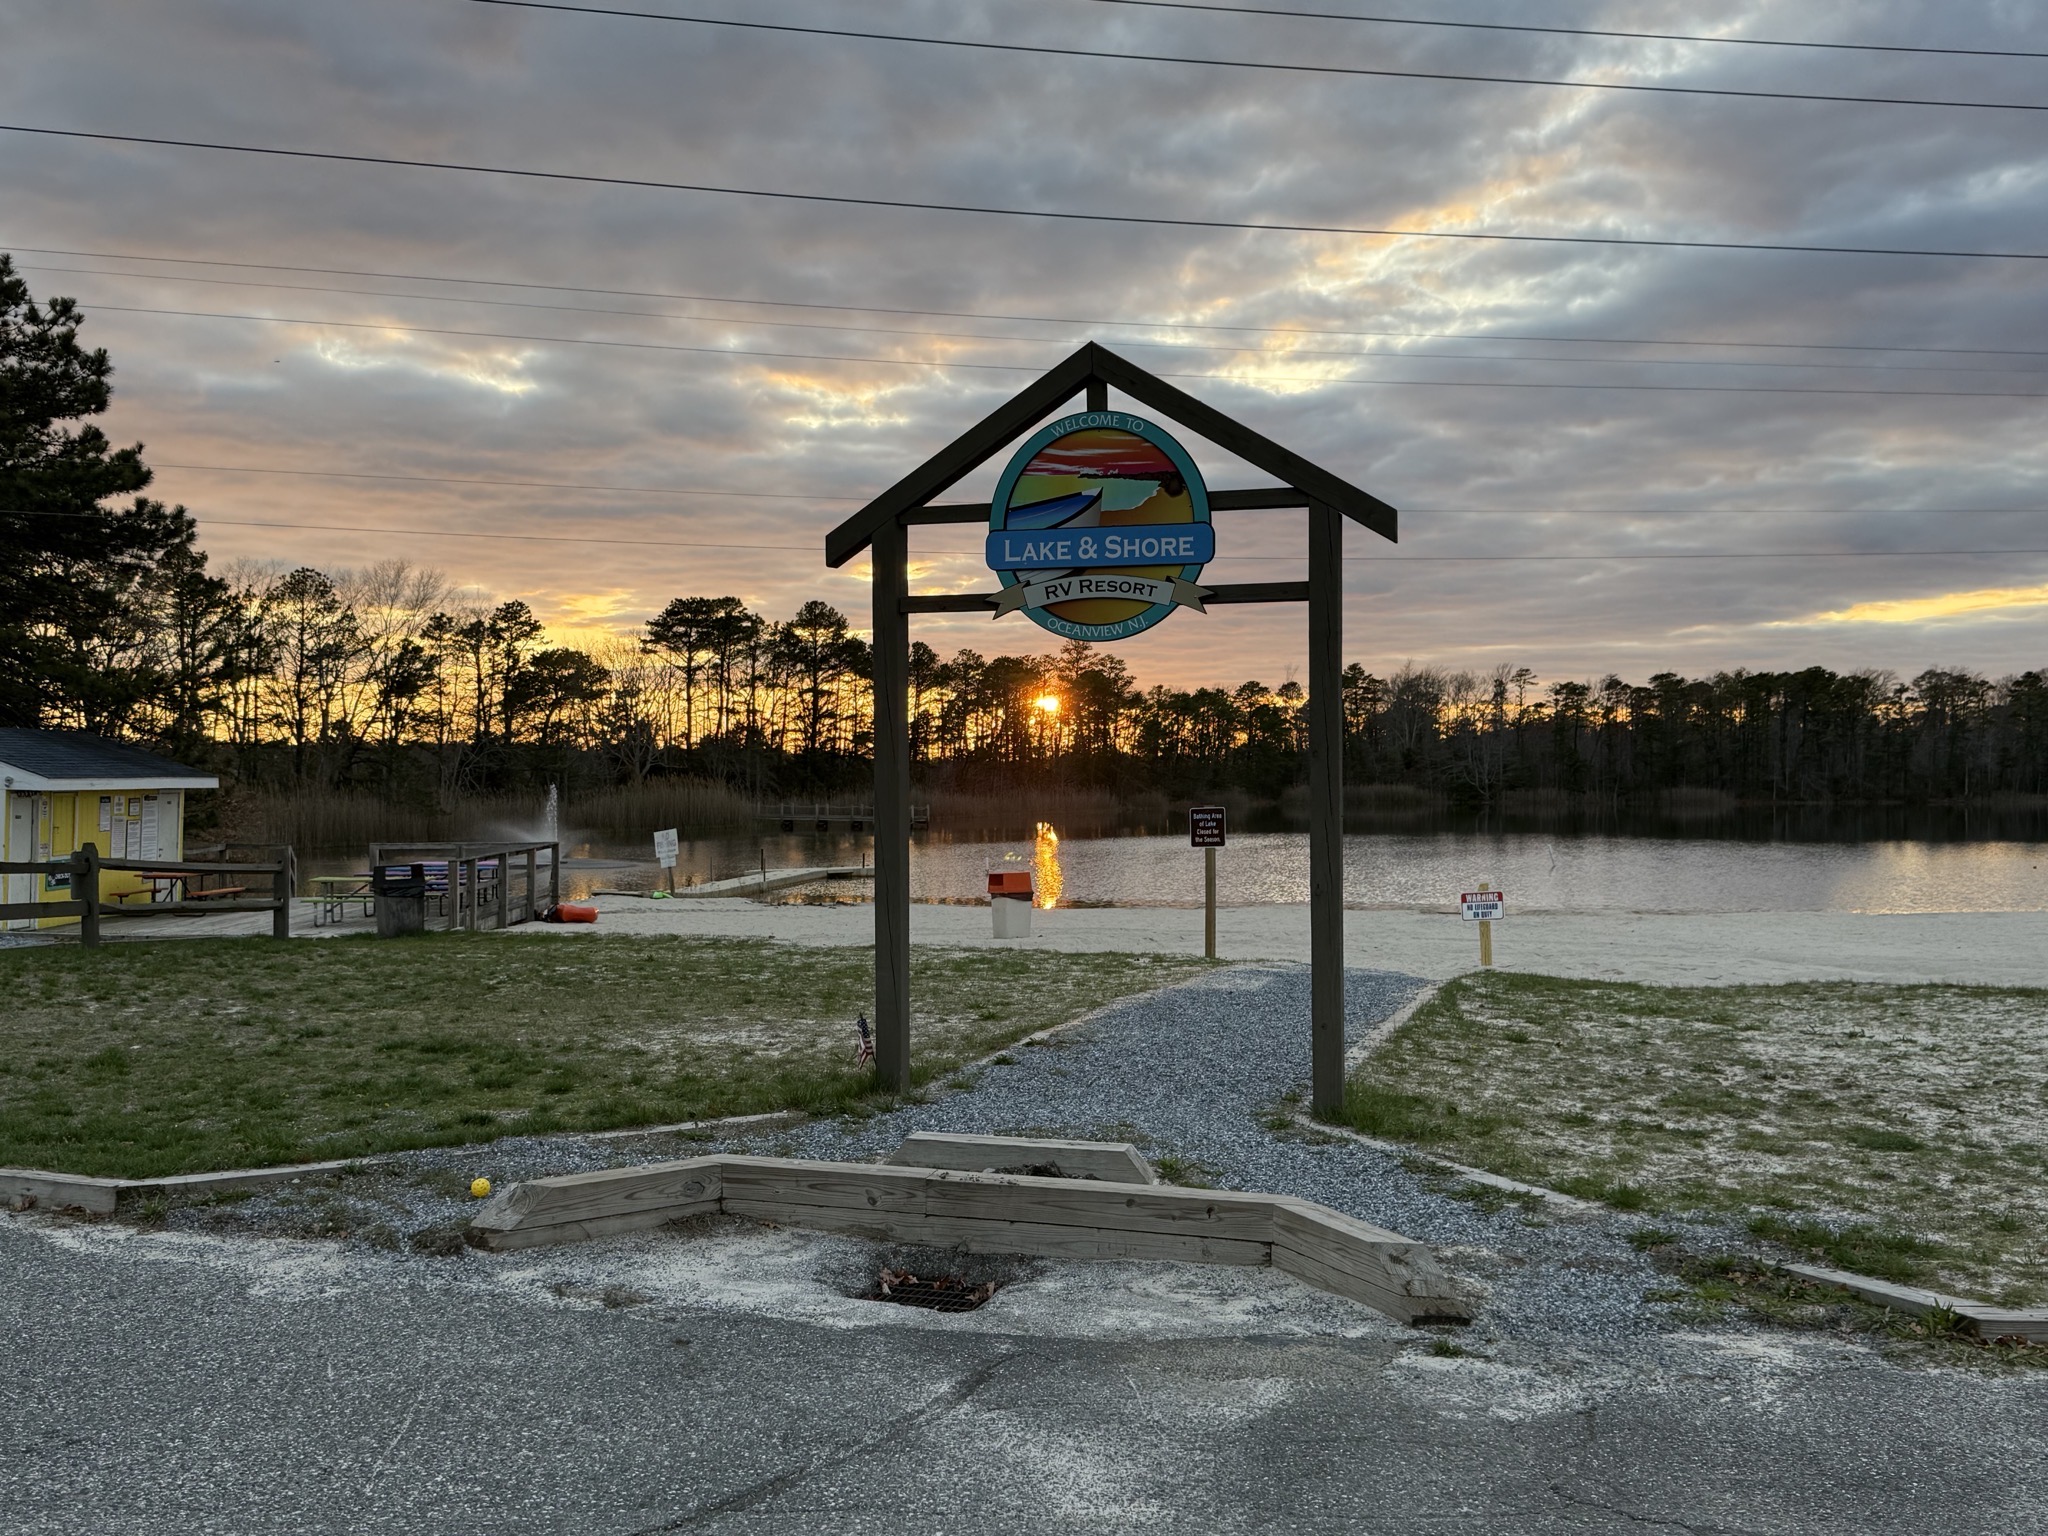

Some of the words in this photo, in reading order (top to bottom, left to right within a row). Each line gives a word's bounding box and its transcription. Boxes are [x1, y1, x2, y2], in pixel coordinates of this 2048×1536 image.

[1050, 415, 1120, 437] WELCOME
[1127, 417, 1144, 432] TO
[1004, 539, 1072, 562] LAKE
[1078, 536, 1098, 559] &
[1104, 536, 1194, 559] SHORE
[1044, 581, 1072, 600] RV
[1079, 579, 1158, 597] RESORT
[1047, 617, 1124, 637] OCEANVIEW
[1465, 893, 1498, 903] WARNING
